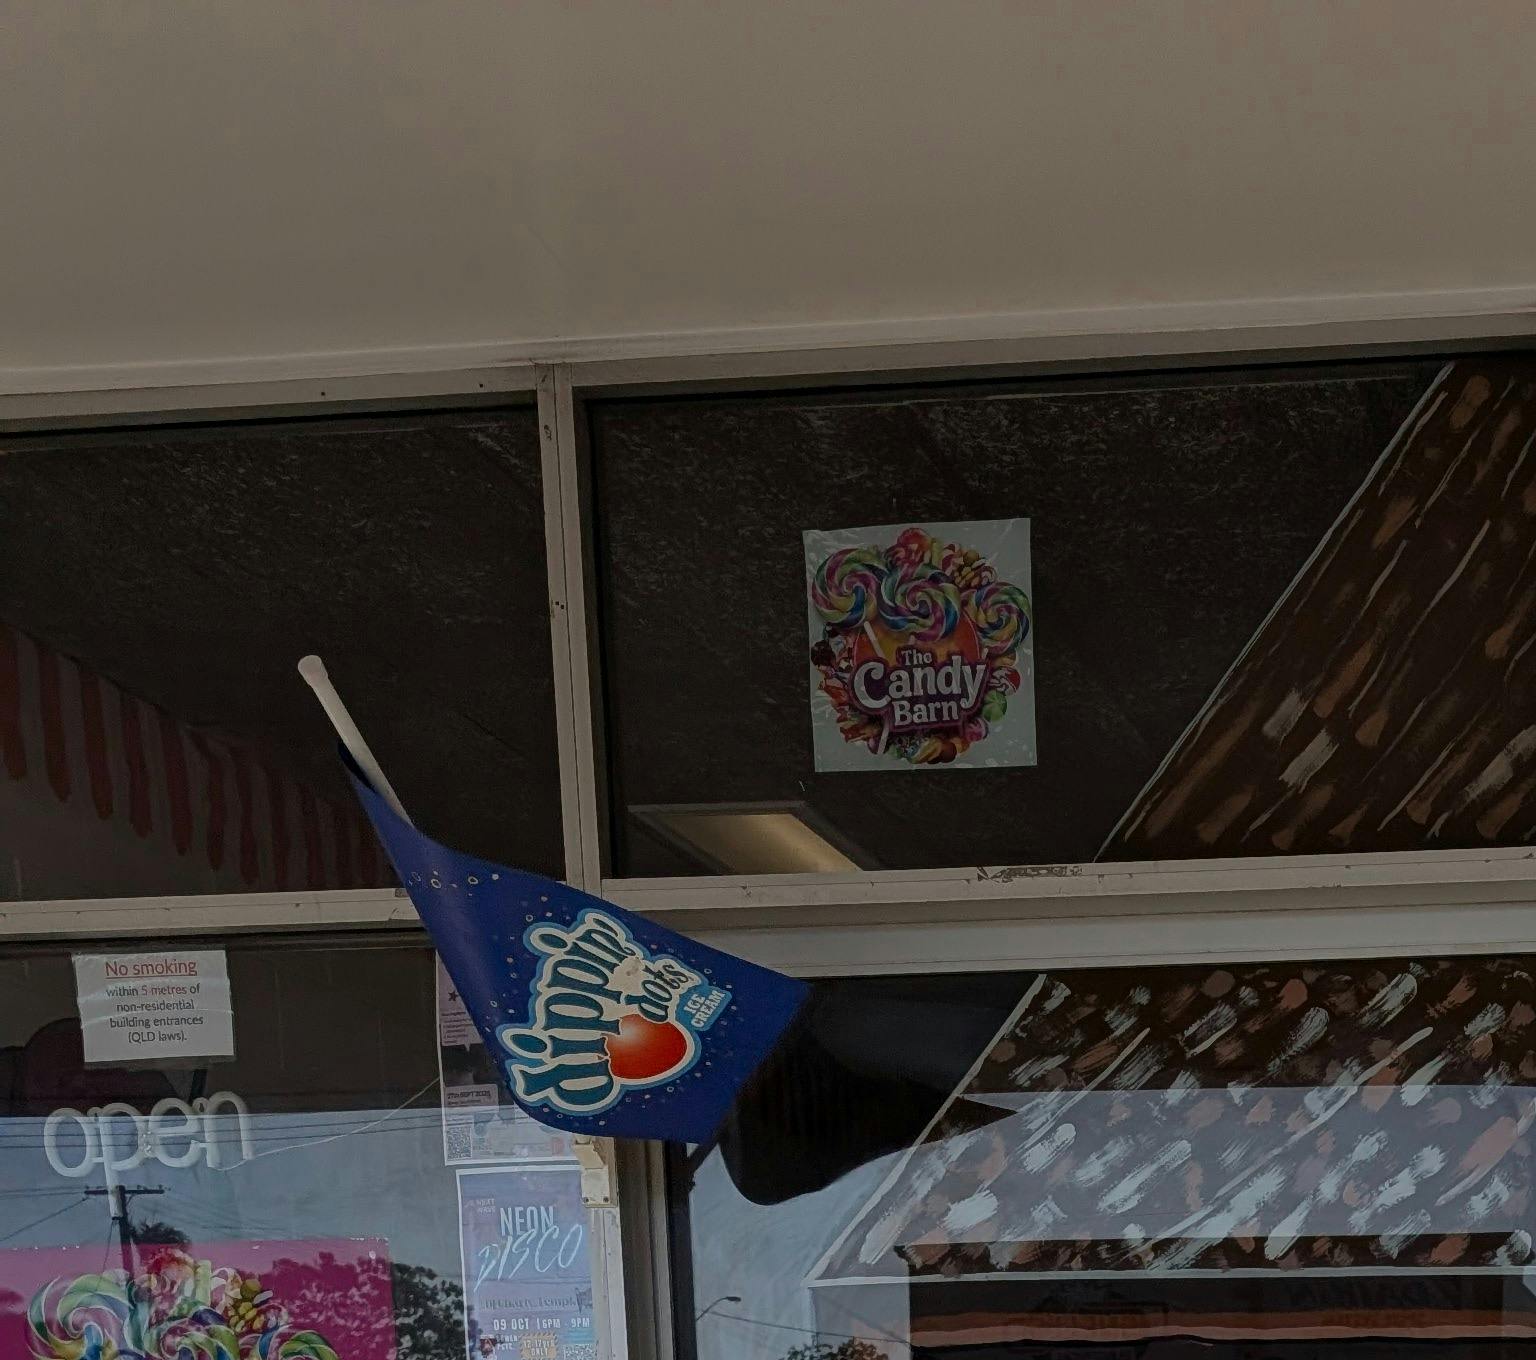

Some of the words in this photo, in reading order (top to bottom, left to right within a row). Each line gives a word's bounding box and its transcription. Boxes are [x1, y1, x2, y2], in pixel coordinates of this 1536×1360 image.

[901, 650, 933, 666] The
[853, 656, 987, 709] Candy
[891, 700, 959, 726] Barn
[105, 961, 128, 977] No
[133, 959, 198, 976] smoking
[105, 985, 138, 997] within
[142, 985, 147, 996] 5
[151, 984, 187, 995] metres
[190, 982, 201, 994] of
[624, 963, 692, 1023] dots
[116, 1003, 195, 1013] non-residential
[684, 993, 706, 1014] ICE
[690, 988, 727, 1028] CREAM
[109, 1017, 151, 1028] building
[153, 1016, 204, 1027] entrances
[128, 1032, 155, 1044] (QLD
[158, 1031, 187, 1043] laws).
[44, 1091, 255, 1217] open
[500, 1206, 554, 1236] NEON
[473, 1224, 583, 1293] DISCO
[493, 1319, 506, 1331] 09
[511, 1318, 529, 1330] OCT
[542, 1318, 560, 1329] 6PM
[571, 1317, 590, 1328] 9PM
[531, 1348, 549, 1357] ONLY
